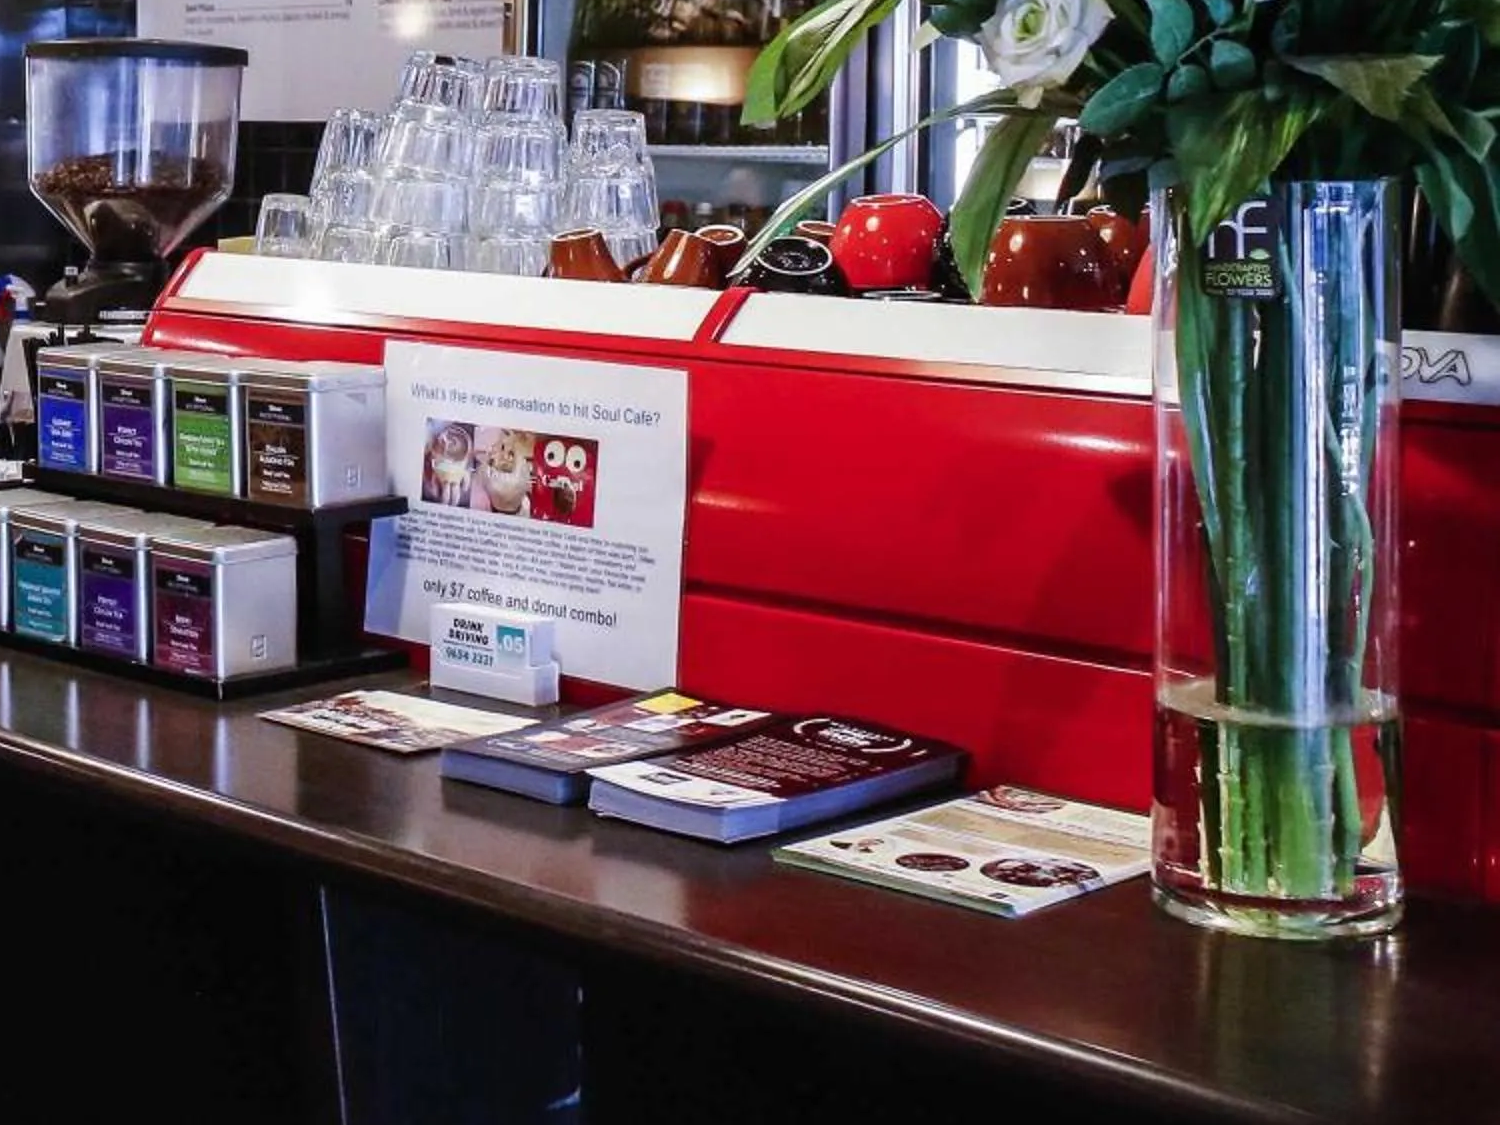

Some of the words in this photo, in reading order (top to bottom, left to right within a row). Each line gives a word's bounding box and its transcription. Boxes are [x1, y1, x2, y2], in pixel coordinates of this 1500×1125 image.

[1204, 272, 1273, 287] FLOWERS
[411, 381, 447, 400] What's
[449, 386, 467, 404] the
[471, 393, 493, 407] new
[497, 394, 555, 415] sensation
[559, 401, 570, 416] to
[573, 403, 589, 418] hit
[592, 404, 621, 423] Soul
[423, 578, 446, 598] only
[449, 580, 465, 598] $7
[467, 586, 501, 606] coffee
[505, 594, 529, 611] and
[532, 599, 567, 618] donut
[570, 606, 617, 627] combo!
[453, 618, 485, 634] DRINK
[448, 628, 489, 645] DRIVING
